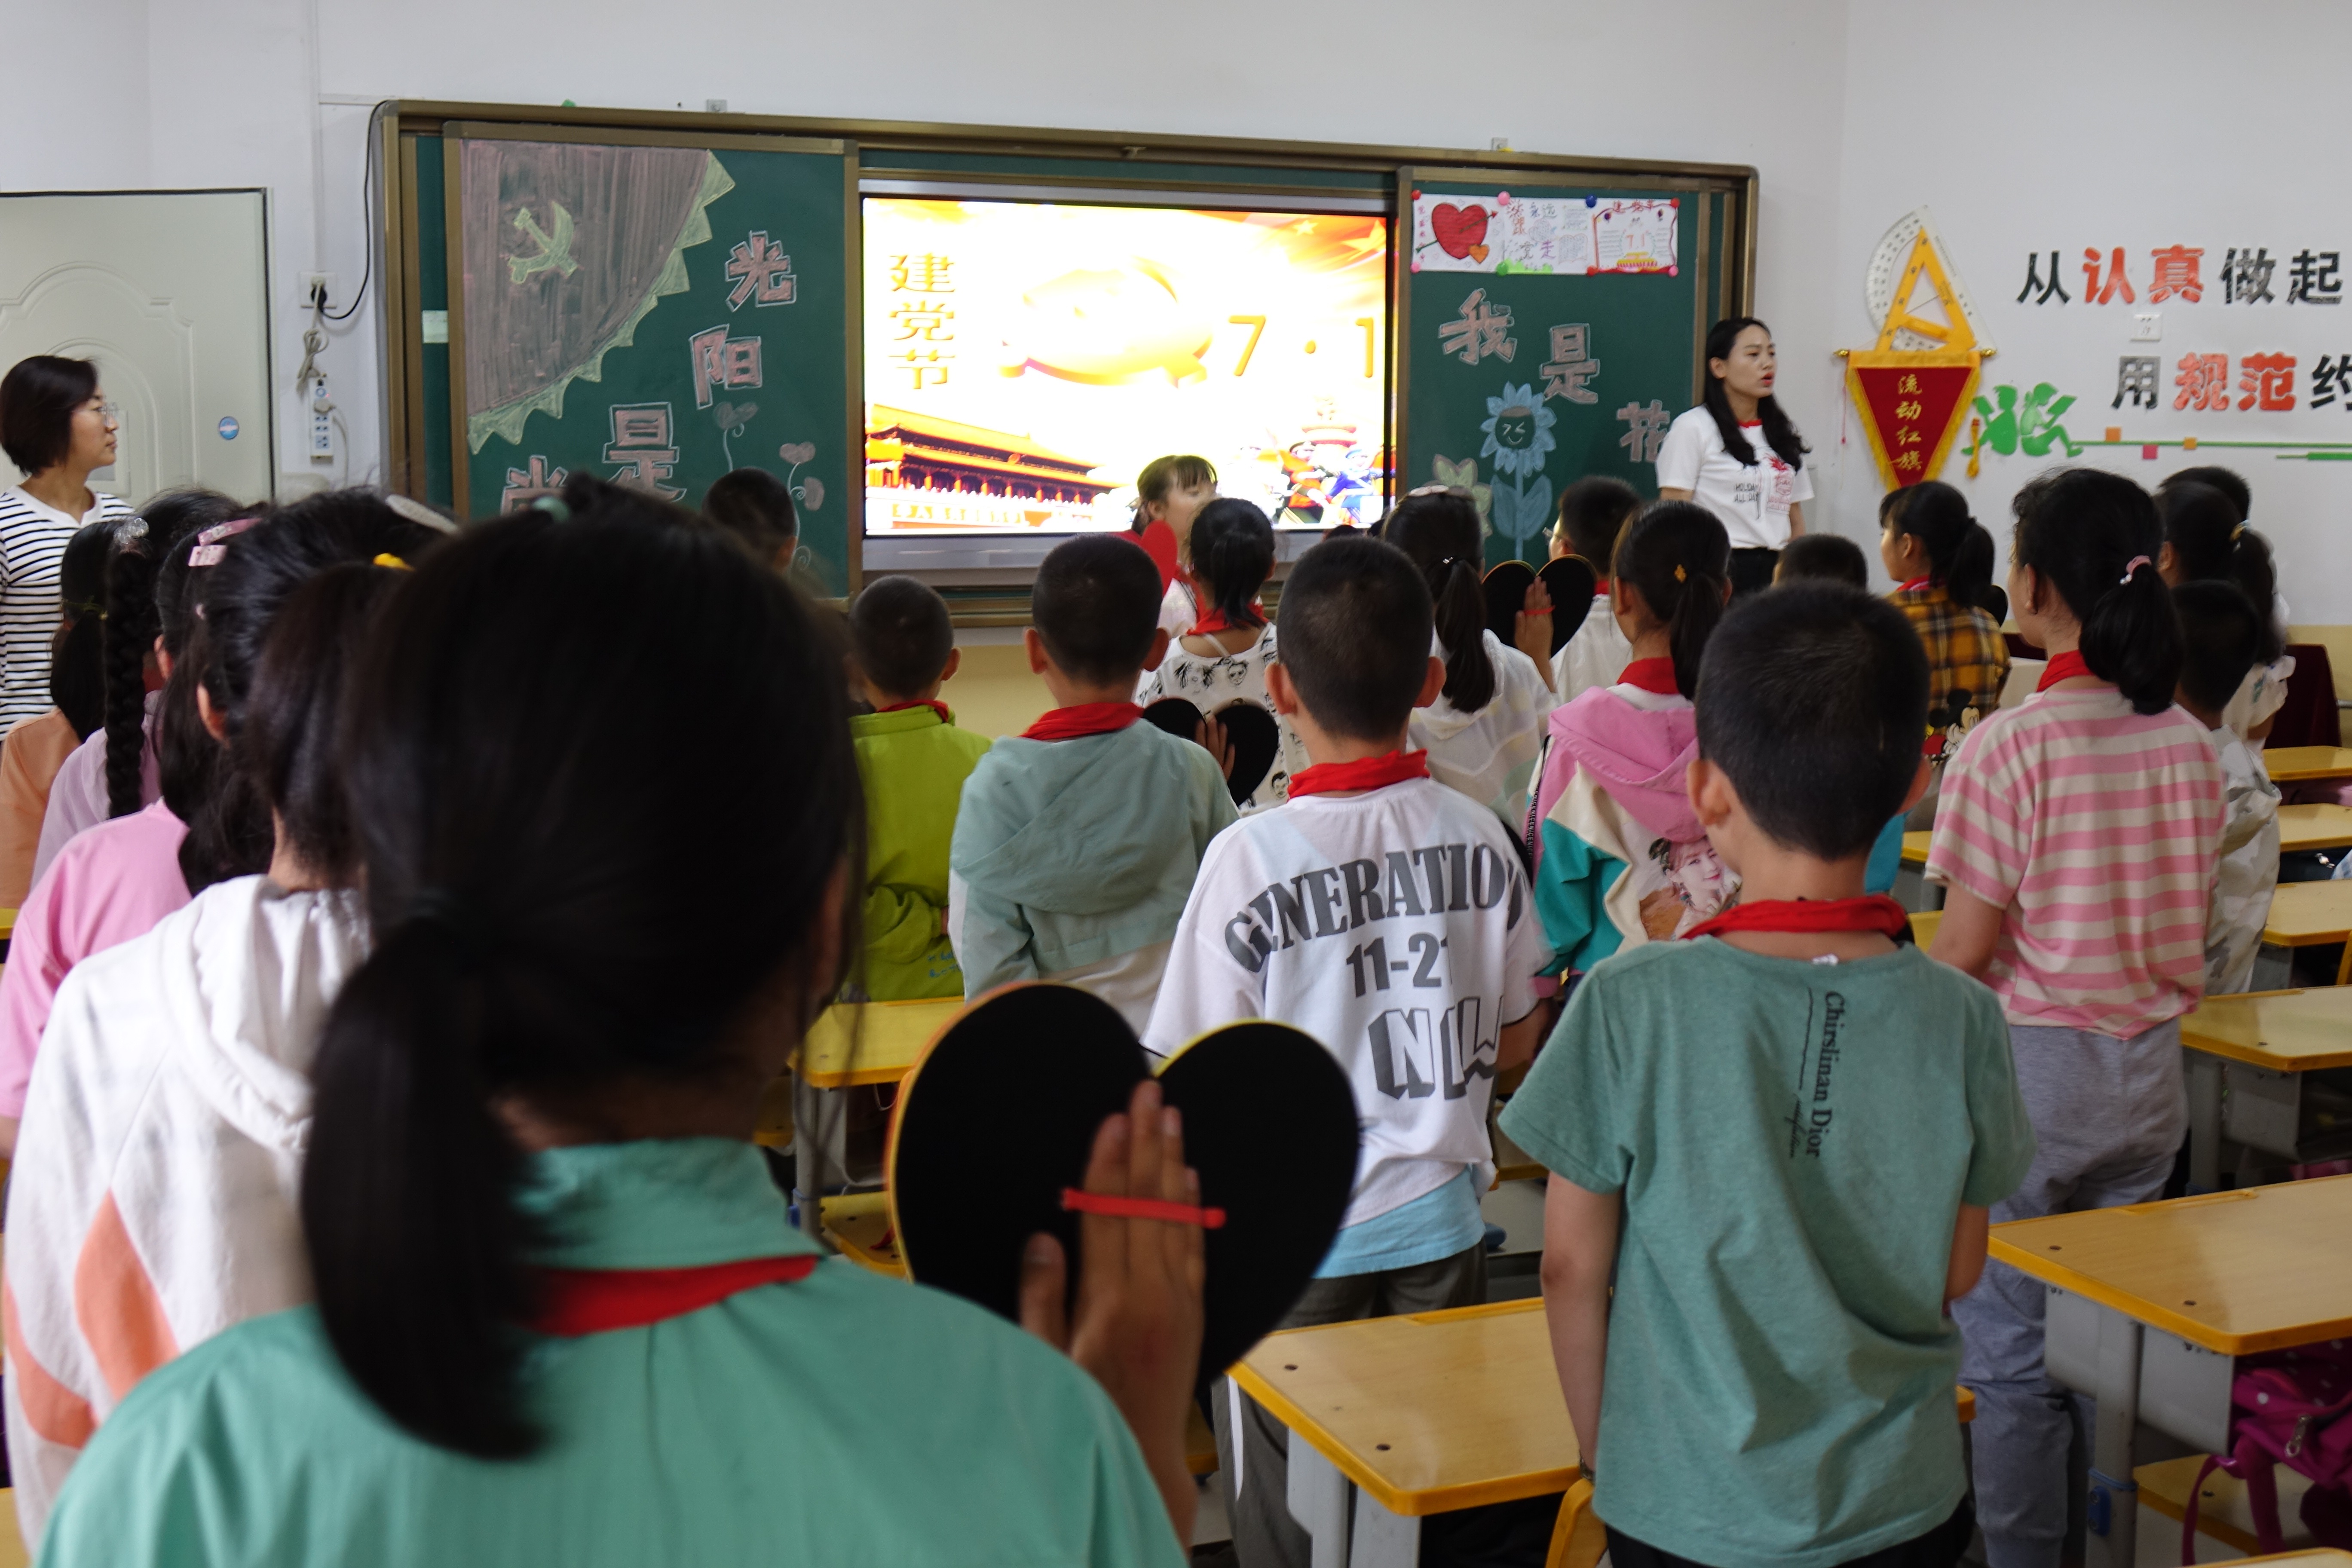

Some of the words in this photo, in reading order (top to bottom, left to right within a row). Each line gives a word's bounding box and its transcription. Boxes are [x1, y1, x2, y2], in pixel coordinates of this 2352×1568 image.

[2016, 244, 2343, 306] 从认真做起
[888, 253, 955, 389] 建党节
[1892, 373, 1923, 471] 流动红旗
[1807, 1108, 1833, 1158] Dior
